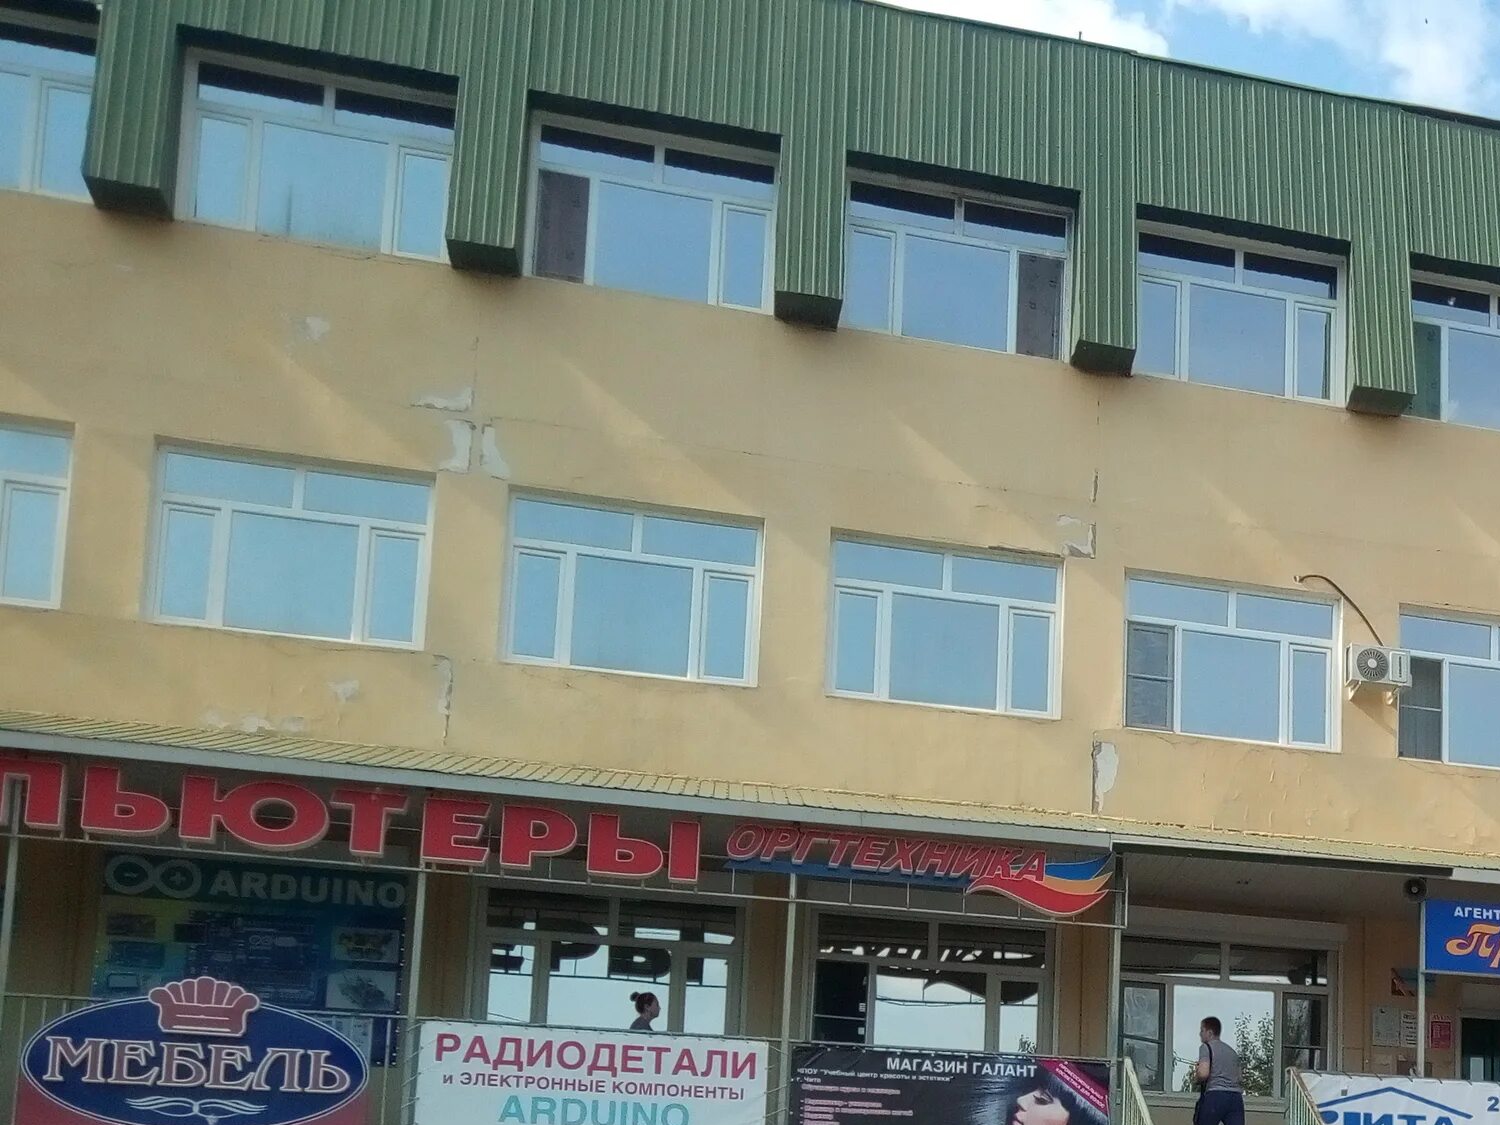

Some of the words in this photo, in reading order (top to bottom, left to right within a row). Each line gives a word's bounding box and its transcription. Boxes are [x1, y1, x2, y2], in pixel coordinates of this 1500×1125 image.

[726, 823, 1047, 882] ОРГТЕХНИКА
[208, 870, 406, 909] ARDUINO
[43, 1036, 351, 1095] МЕБЕЛЬ
[435, 1032, 757, 1080] РАДИОДЕТАЛИ
[886, 1057, 968, 1075] МАГАЗИН
[972, 1062, 1038, 1078] ГАЛАНТ
[442, 1075, 454, 1085] и
[459, 1071, 606, 1093] ЭЛЕКТРОННЫЕ
[612, 1081, 745, 1101] КОМПОНЕНТЫ
[1487, 1096, 1499, 1112] 2
